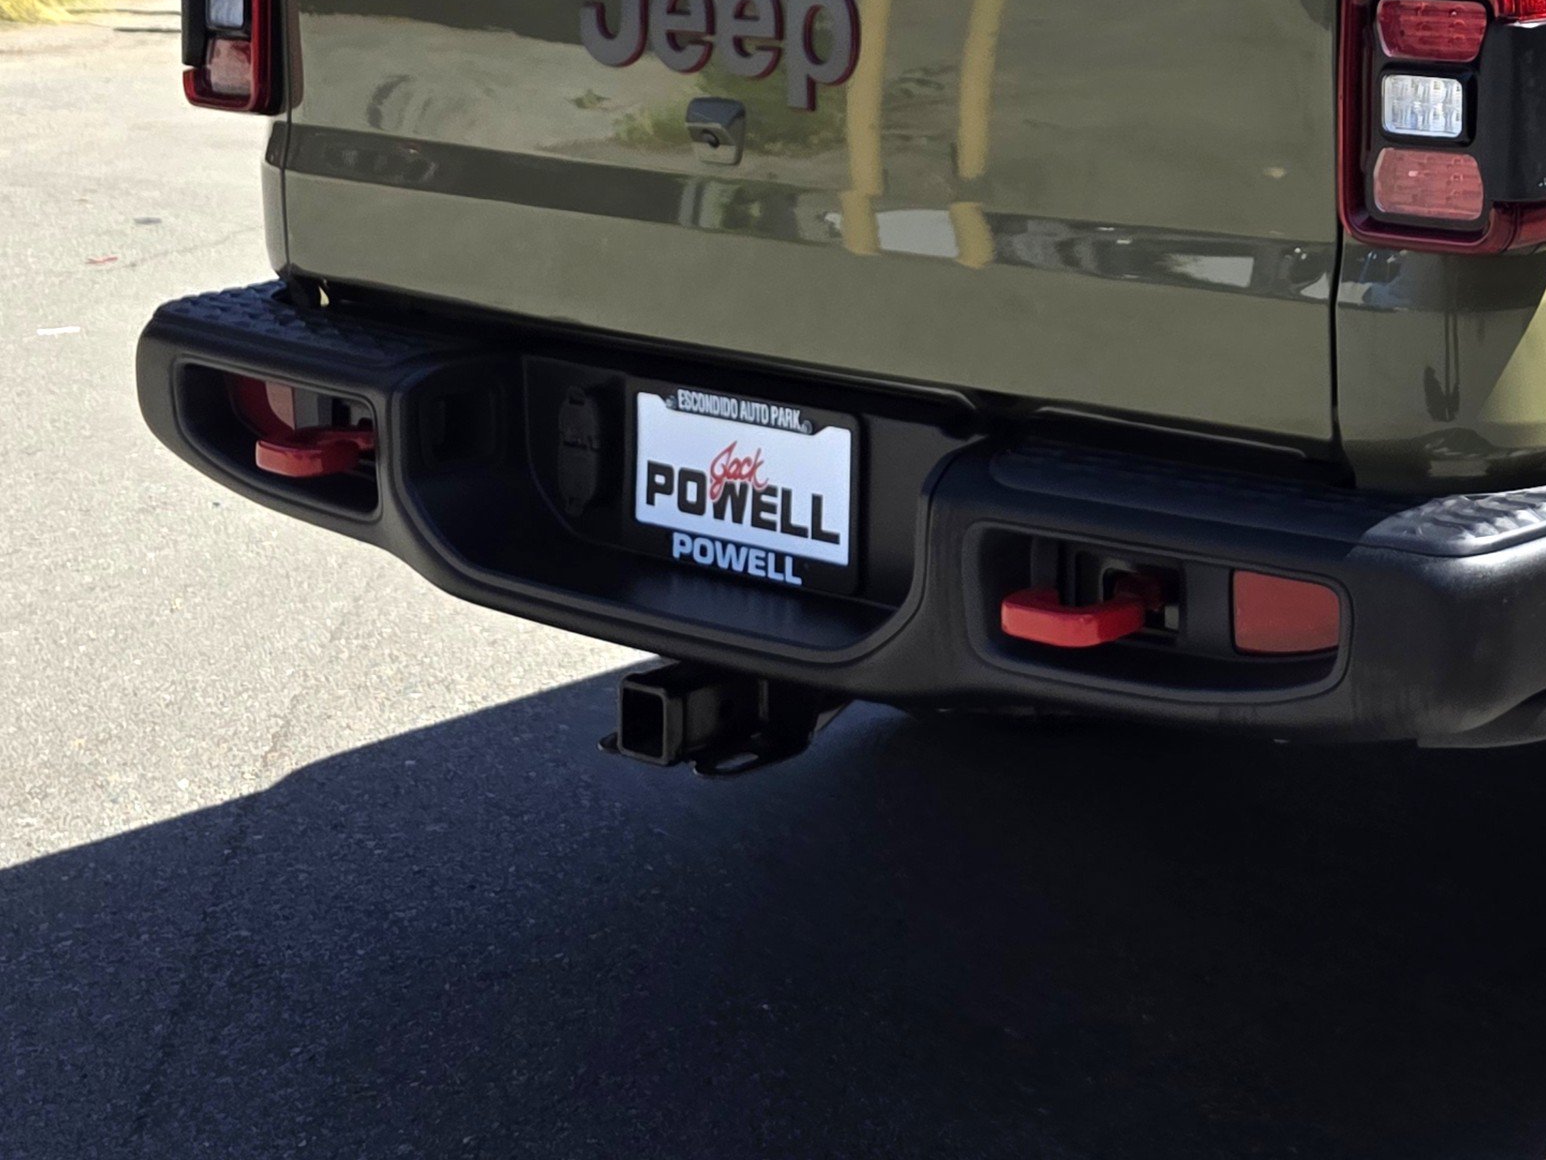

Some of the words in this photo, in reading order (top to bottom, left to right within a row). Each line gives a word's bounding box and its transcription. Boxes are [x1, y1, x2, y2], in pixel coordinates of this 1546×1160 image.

[677, 389, 738, 420] ESCONDIDO
[739, 400, 770, 426] AUTO
[770, 405, 802, 432] PARK
[709, 441, 769, 502] Jack
[646, 460, 841, 546] POWELL
[671, 532, 803, 586] POWELL
